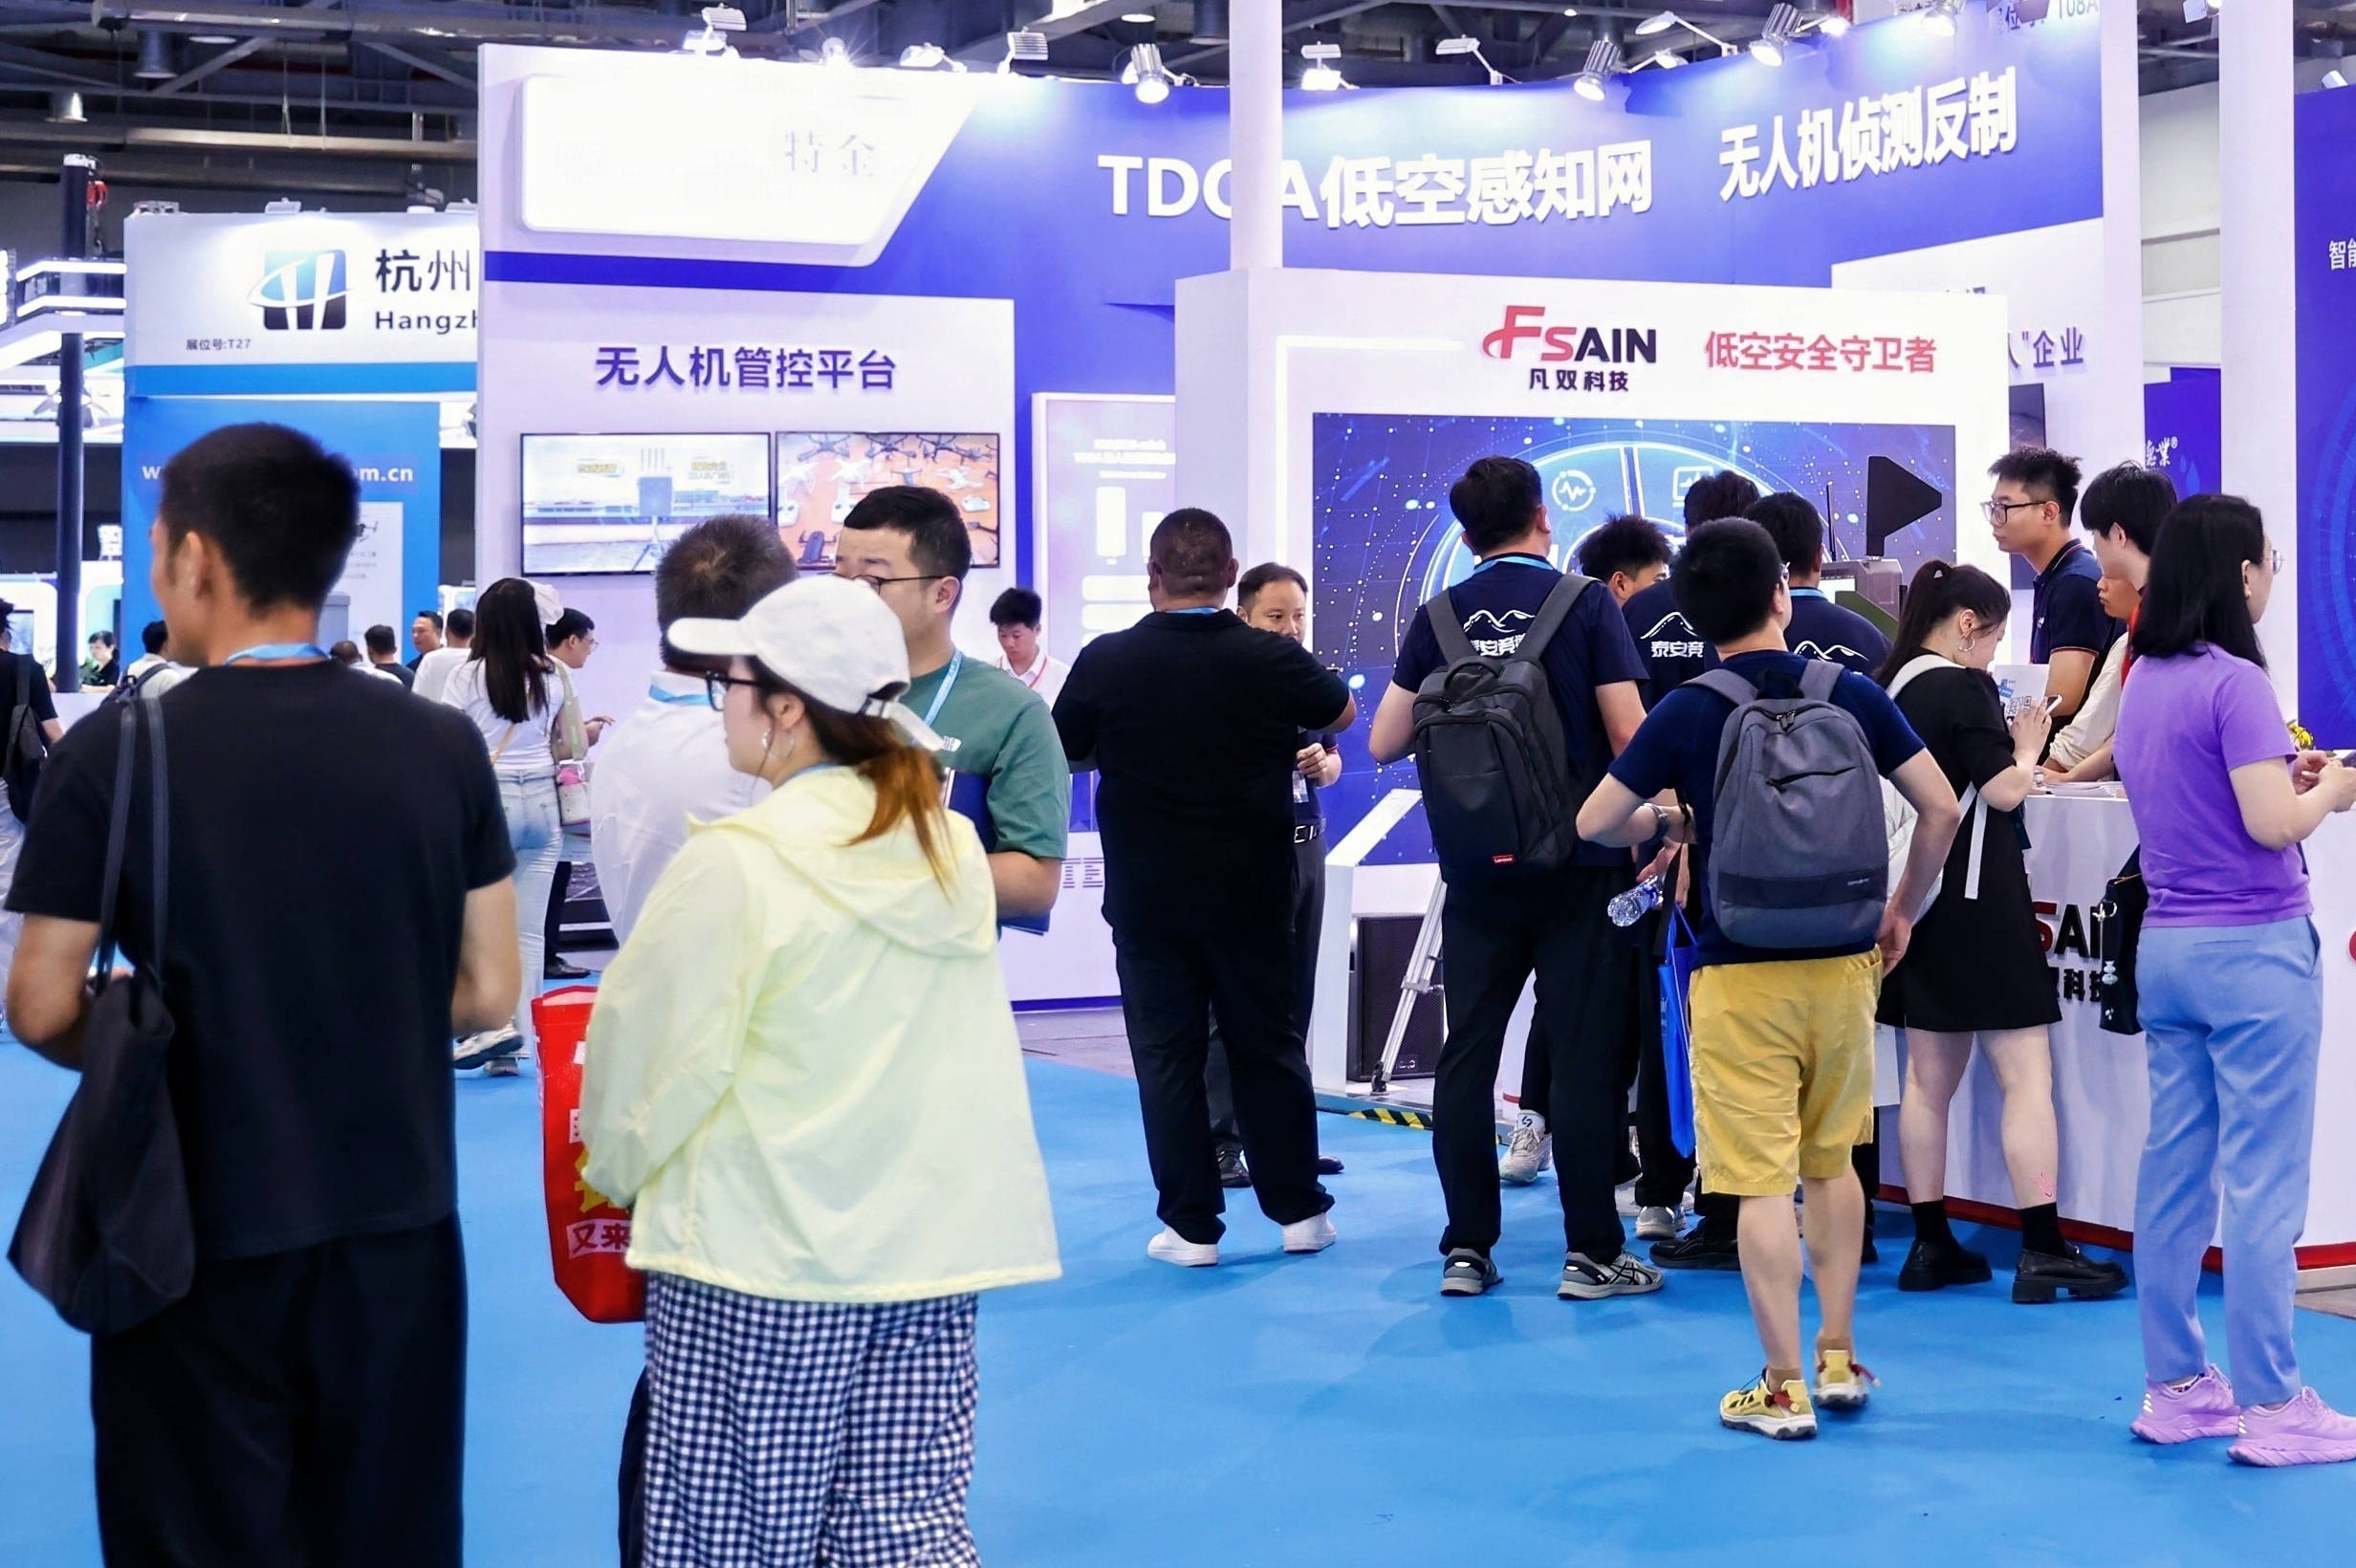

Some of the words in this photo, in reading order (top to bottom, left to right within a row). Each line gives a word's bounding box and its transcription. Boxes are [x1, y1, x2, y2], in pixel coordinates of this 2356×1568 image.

[1719, 65, 2018, 203] 无人机侦测反制
[375, 249, 472, 294] 杭州
[1481, 304, 1657, 363] FSAIN
[1705, 331, 1937, 374] 低空安全守卫者
[595, 344, 897, 390] 无人机管控平台
[1529, 367, 1629, 392] 凡双科技
